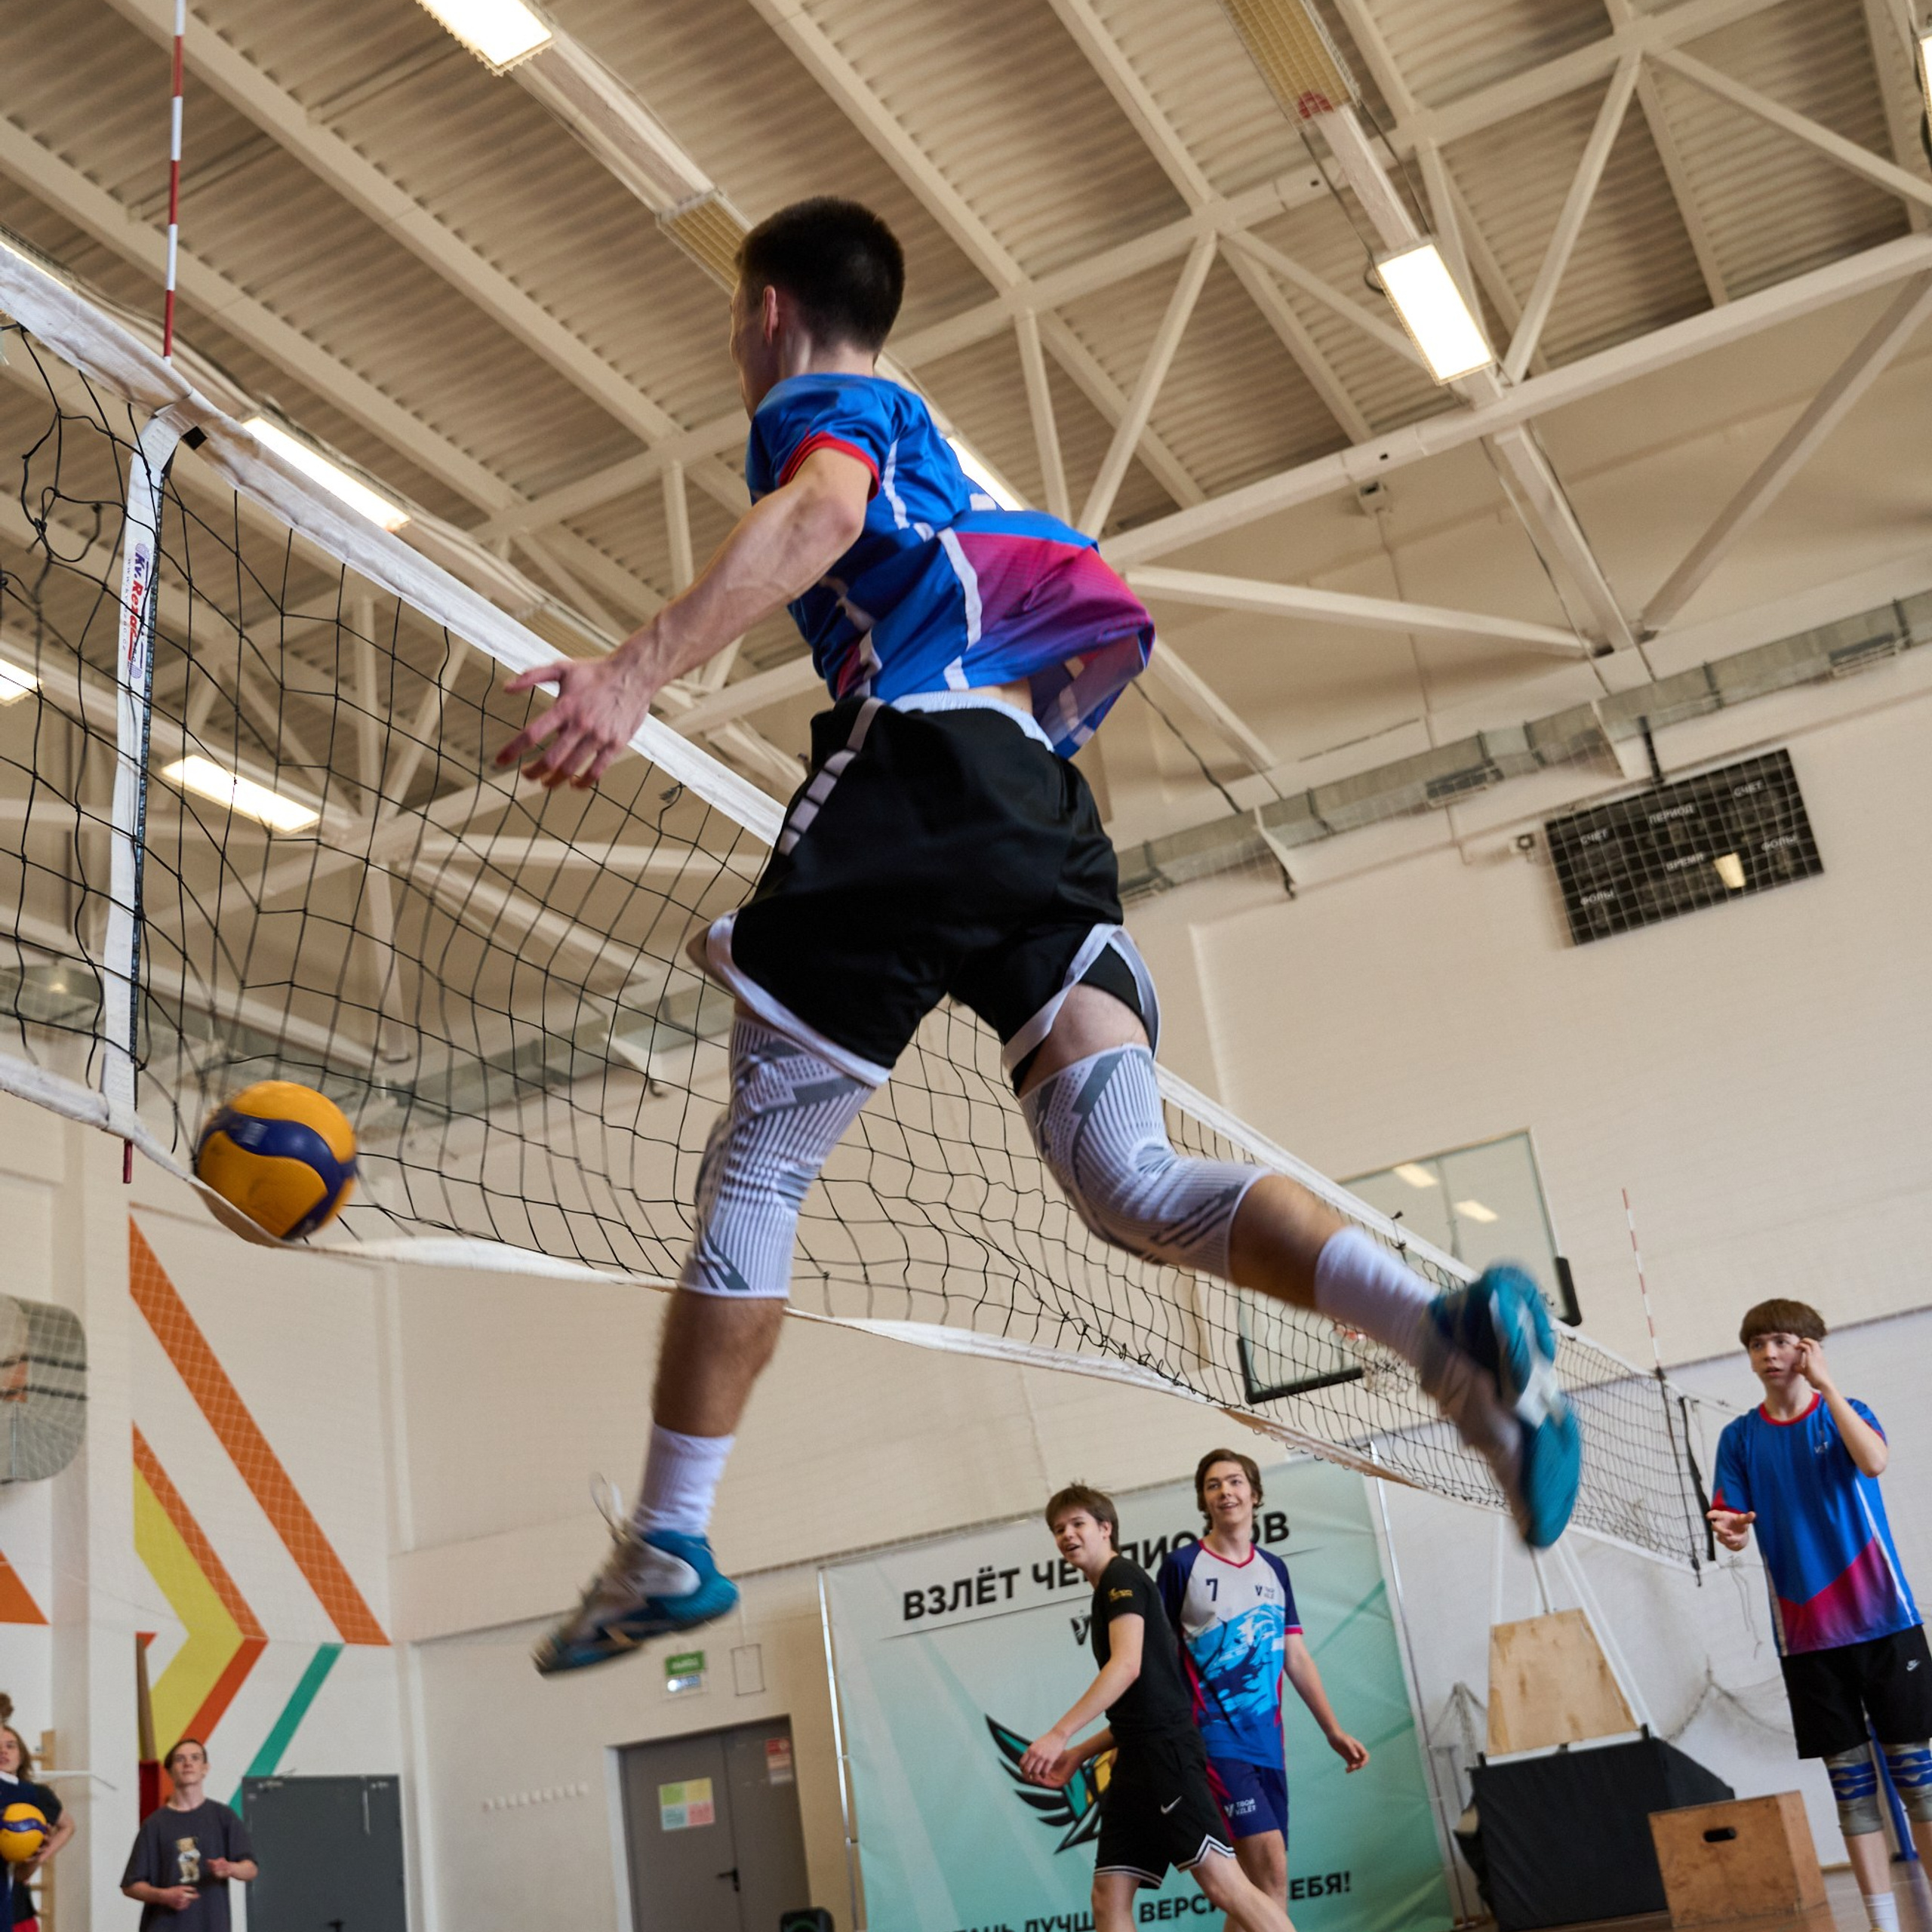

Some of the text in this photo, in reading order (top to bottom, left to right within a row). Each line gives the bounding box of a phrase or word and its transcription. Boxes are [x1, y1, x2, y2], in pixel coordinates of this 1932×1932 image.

[1648, 803, 1694, 825] ПЕРИОД
[1580, 889, 1615, 906] ФОЛЫ
[903, 1565, 1021, 1621] ВЗЛЁТ
[1205, 1577, 1218, 1601] 7
[1290, 1870, 1351, 1901] ЕБЯ!
